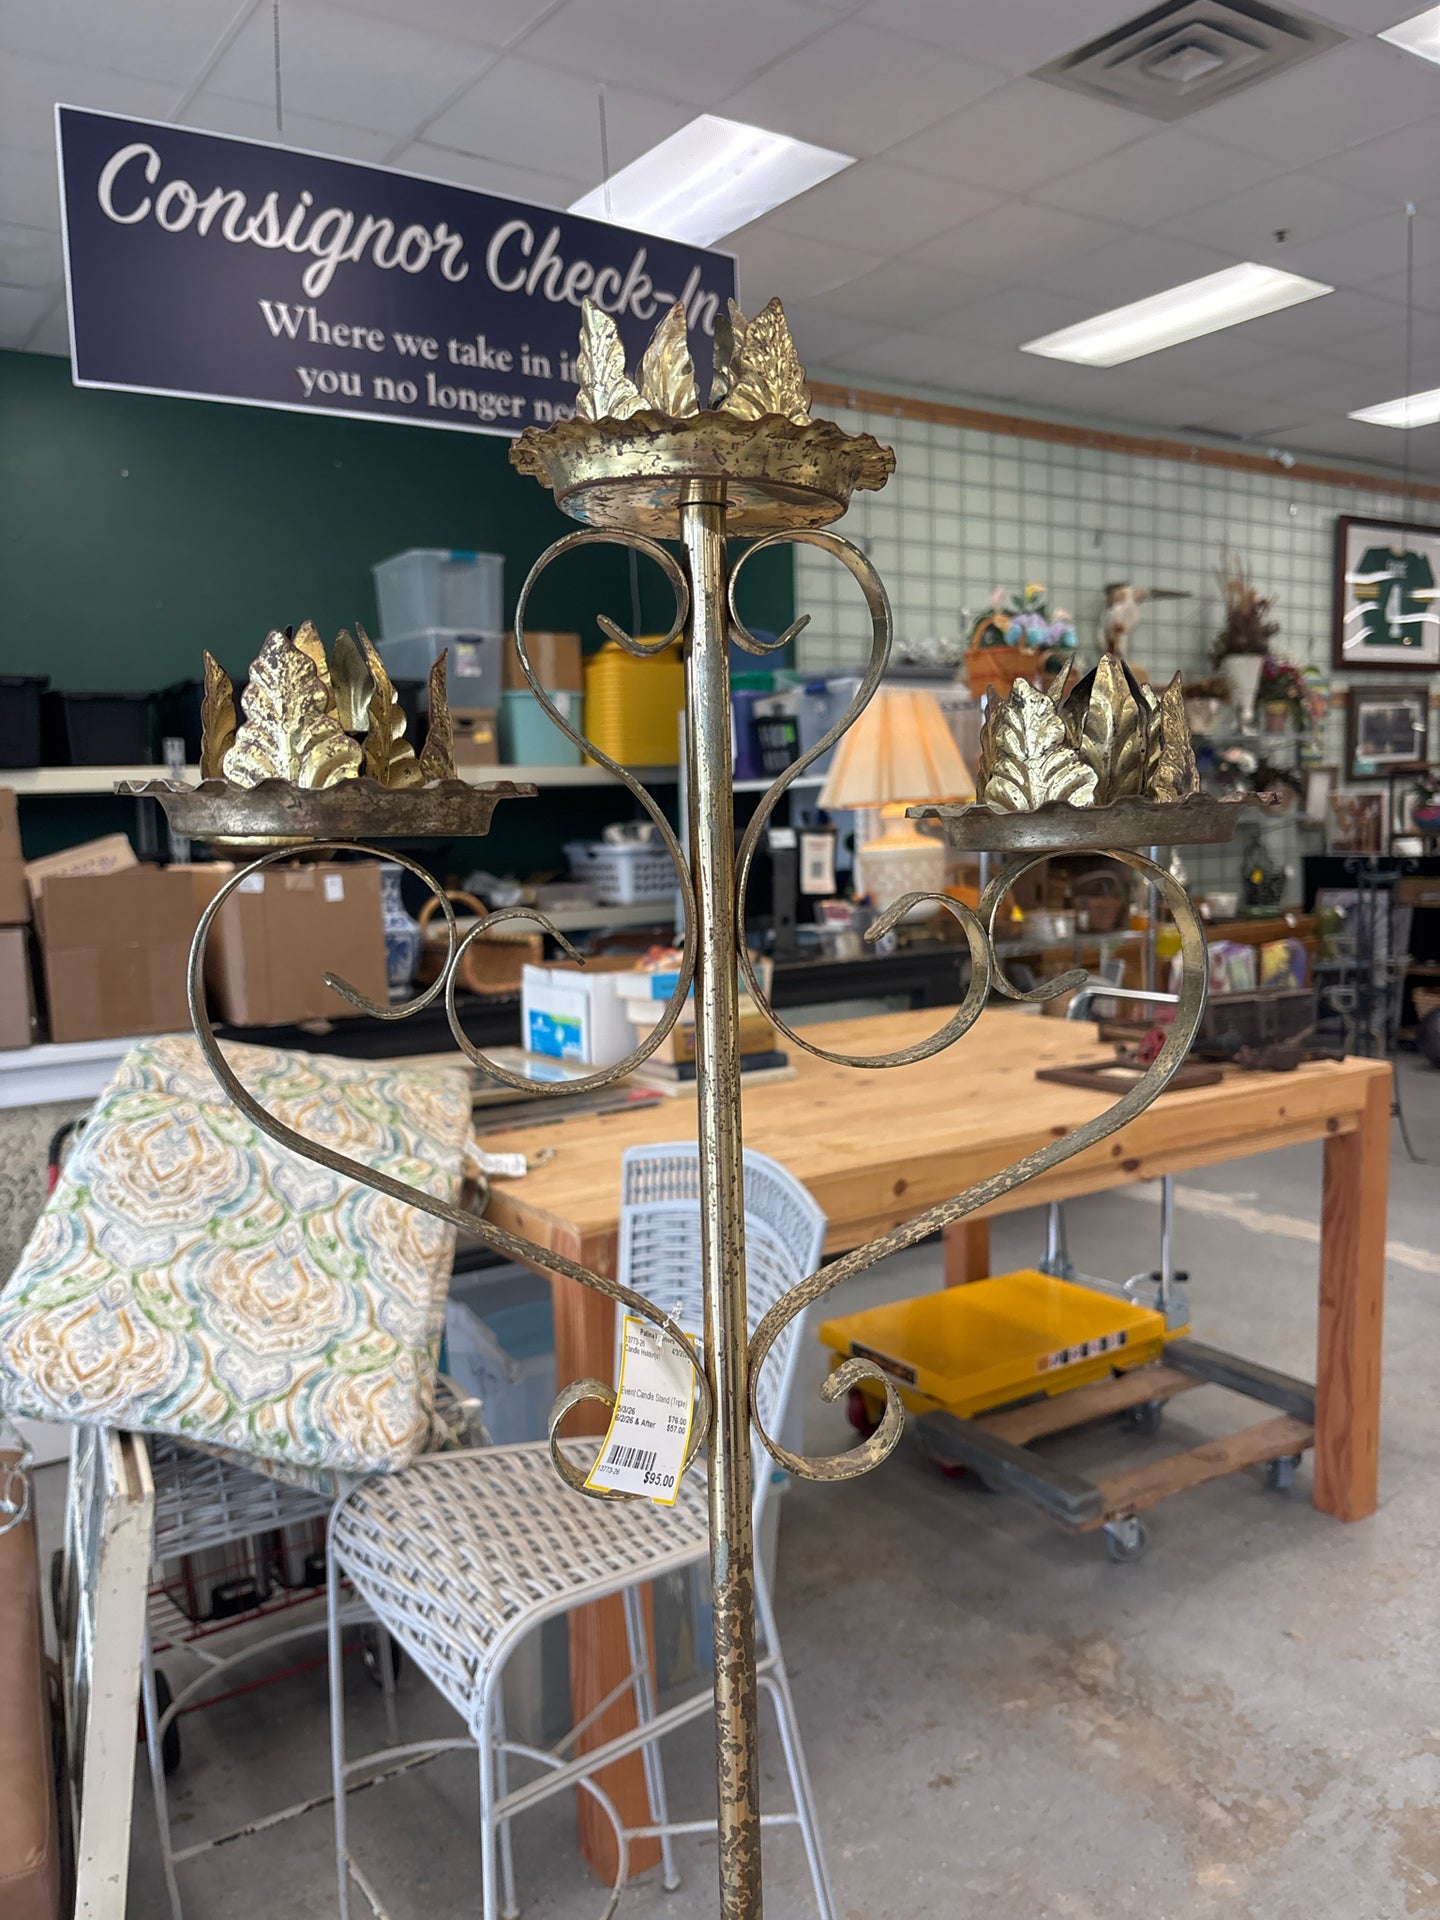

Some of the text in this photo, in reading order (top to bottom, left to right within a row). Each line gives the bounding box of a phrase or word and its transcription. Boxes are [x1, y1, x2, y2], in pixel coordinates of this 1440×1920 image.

[98, 143, 719, 337] Consignor Check-In
[259, 299, 386, 352] Where
[392, 331, 440, 361] we
[447, 333, 514, 373] take
[521, 342, 553, 379] in
[297, 366, 364, 398] you
[373, 376, 419, 404] no
[426, 371, 526, 421] longer
[621, 1386, 635, 1397] Event
[637, 1389, 654, 1400] Candle
[655, 1393, 670, 1405] Stand
[634, 1417, 640, 1425] &
[641, 1419, 656, 1429] After
[666, 1424, 686, 1434] $57.00
[643, 1471, 675, 1488] $95.00
